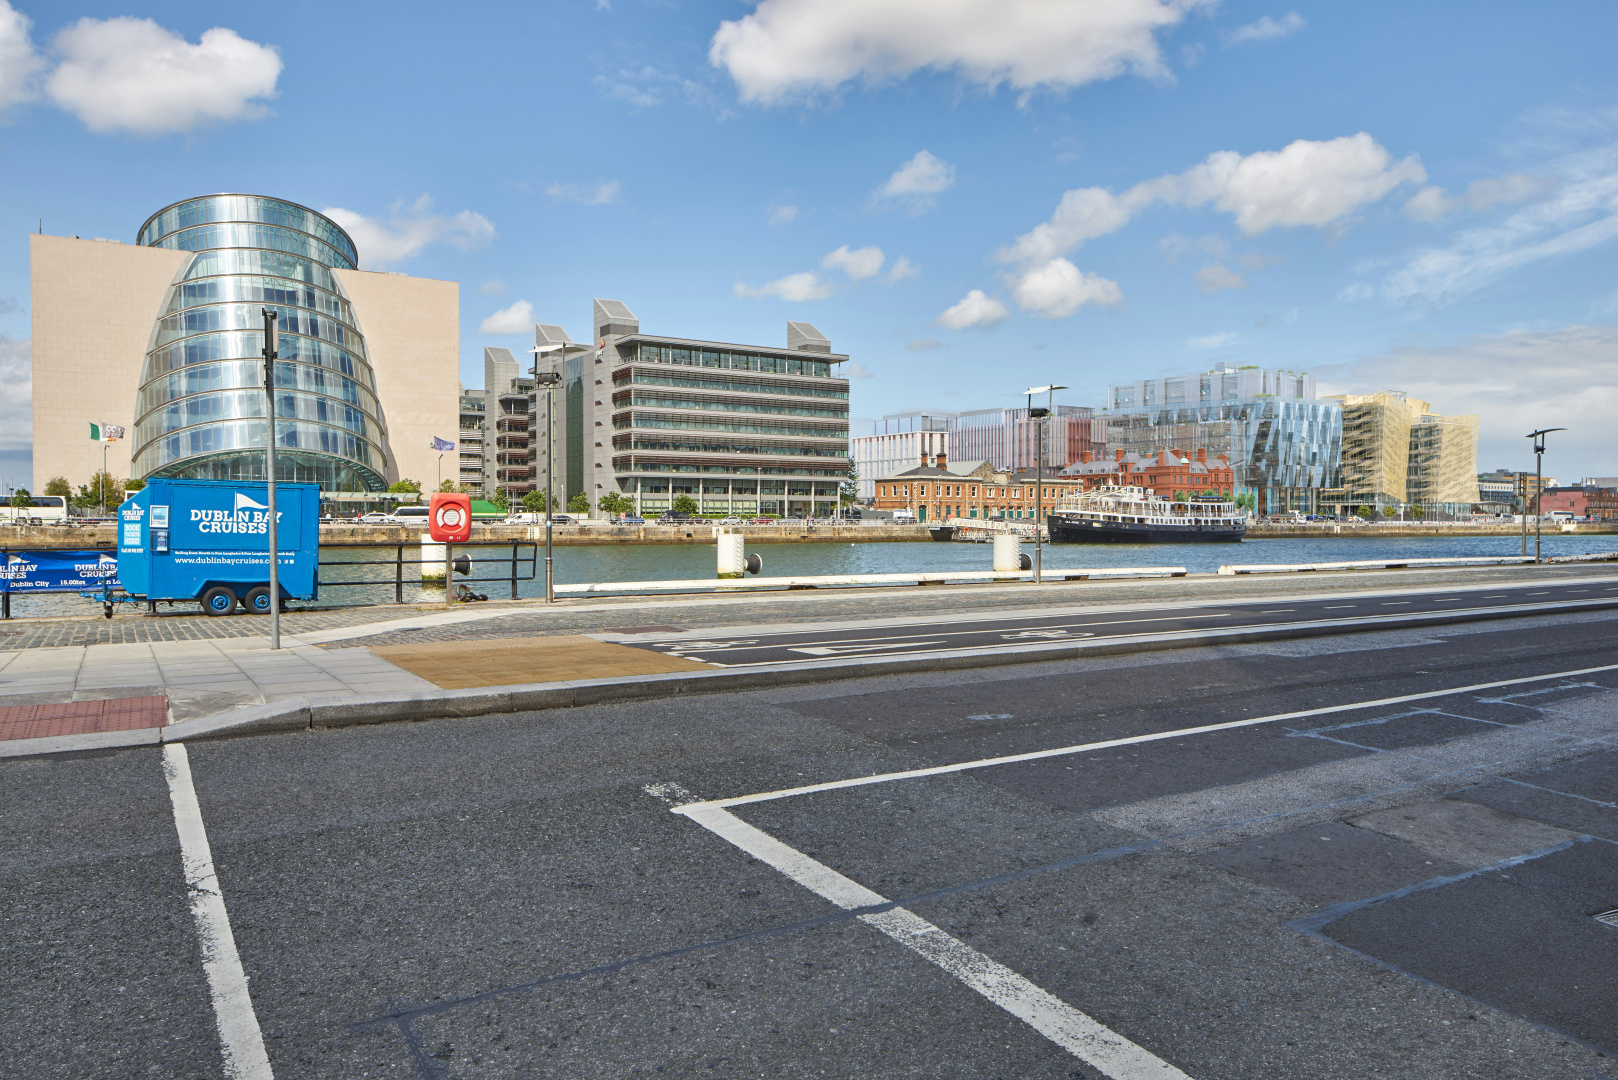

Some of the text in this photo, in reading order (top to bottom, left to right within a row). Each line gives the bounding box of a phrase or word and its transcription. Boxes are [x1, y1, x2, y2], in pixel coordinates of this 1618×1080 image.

[190, 509, 250, 523] DUBLIN
[125, 524, 140, 532] BOOK
[199, 521, 267, 534] CRUISES
[175, 557, 281, 565] www.dublinbaycruises.c
